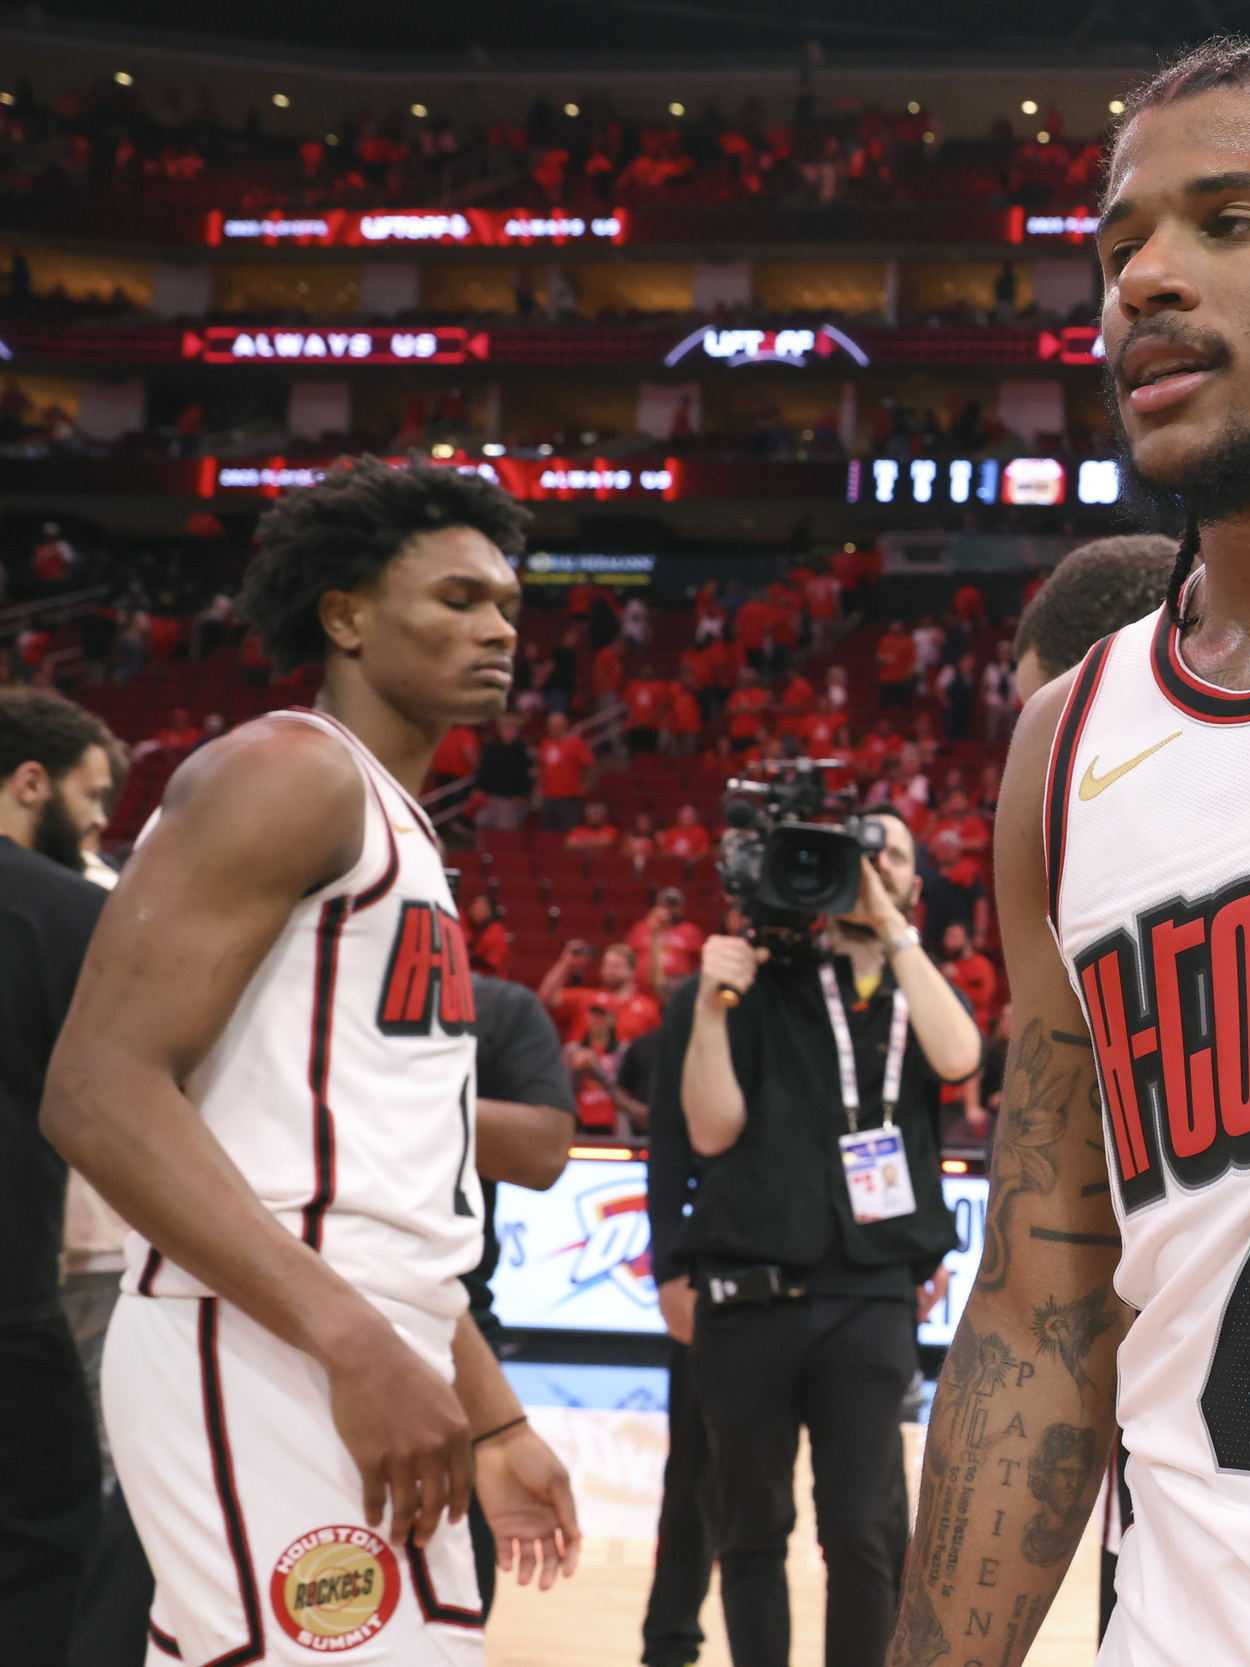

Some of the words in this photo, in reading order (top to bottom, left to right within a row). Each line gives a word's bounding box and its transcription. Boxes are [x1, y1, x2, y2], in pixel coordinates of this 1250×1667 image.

[231, 332, 373, 358] ALWAYS
[390, 332, 437, 358] US
[276, 1527, 384, 1575] HOUSTON
[297, 1613, 383, 1650] SUMMIT
